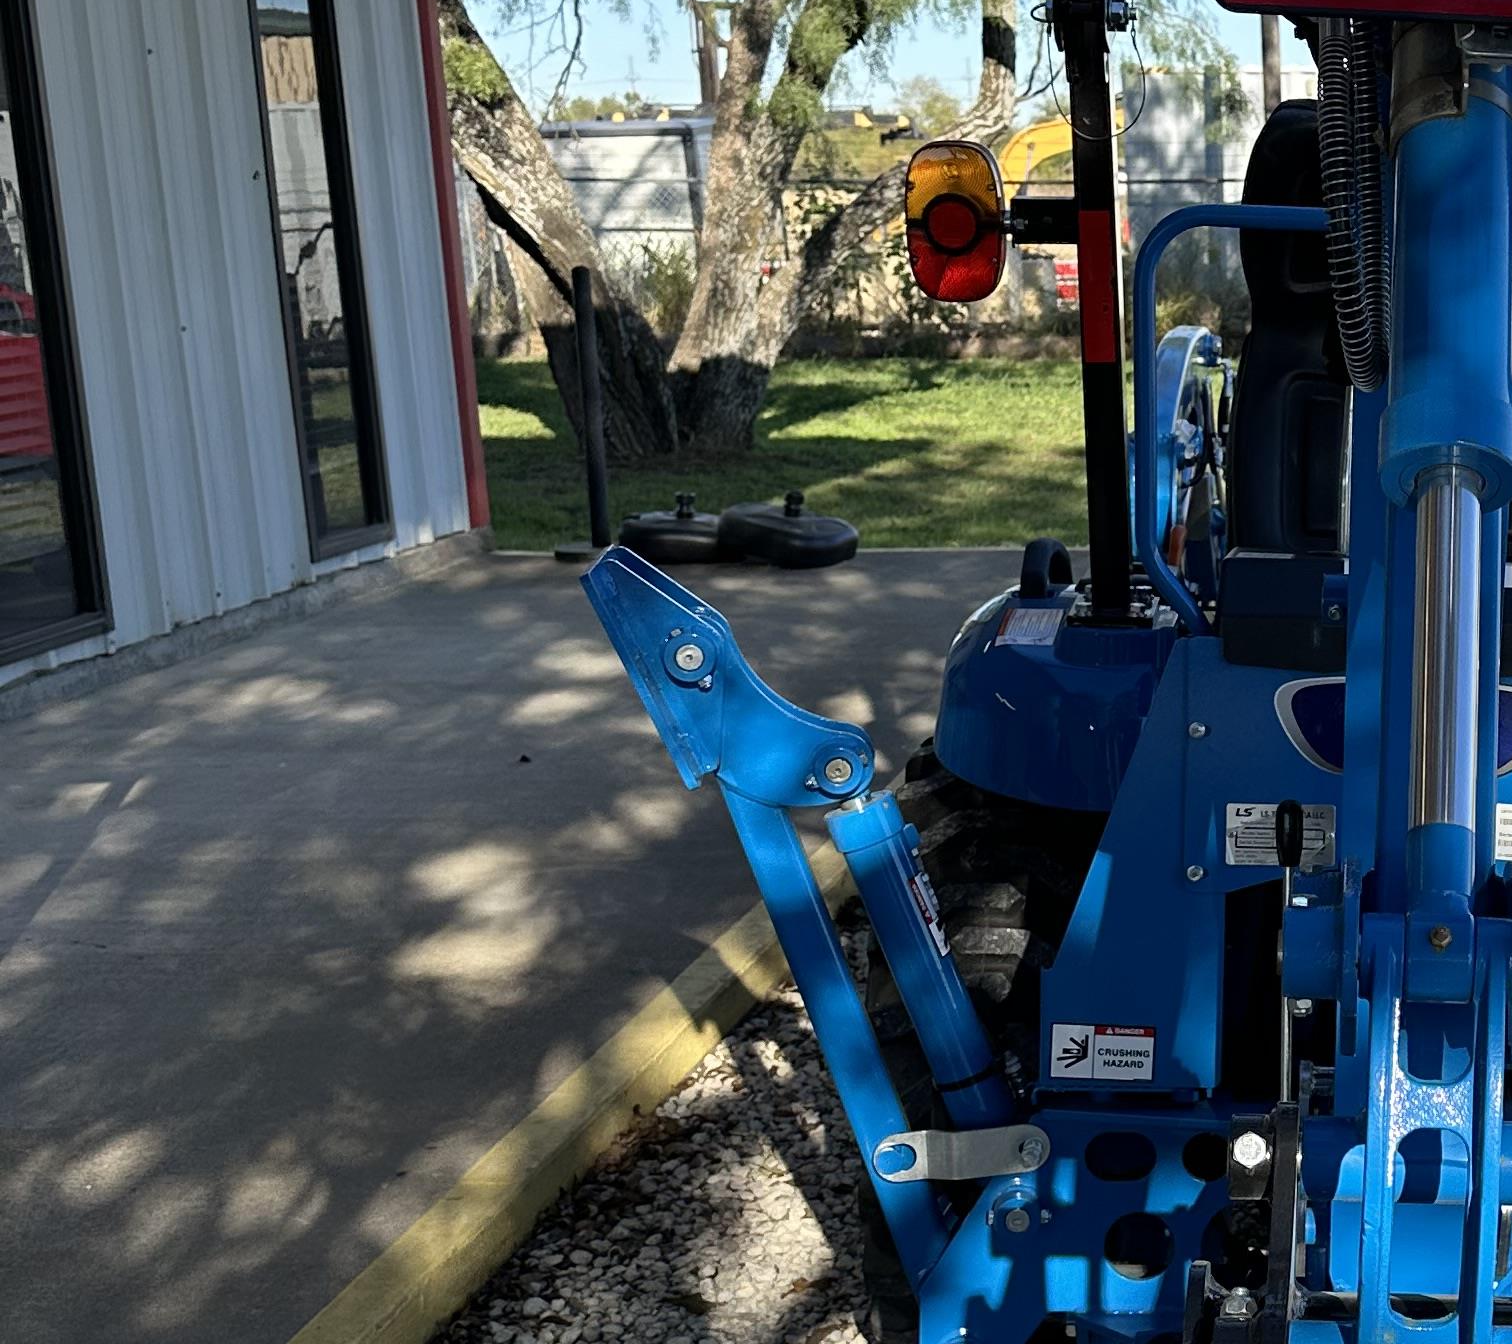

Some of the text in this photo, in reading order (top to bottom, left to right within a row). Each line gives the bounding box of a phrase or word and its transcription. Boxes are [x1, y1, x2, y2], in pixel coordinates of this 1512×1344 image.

[1235, 807, 1256, 817] LS
[1097, 1047, 1151, 1058] CRUSHING
[1103, 1059, 1145, 1069] HAZARD
